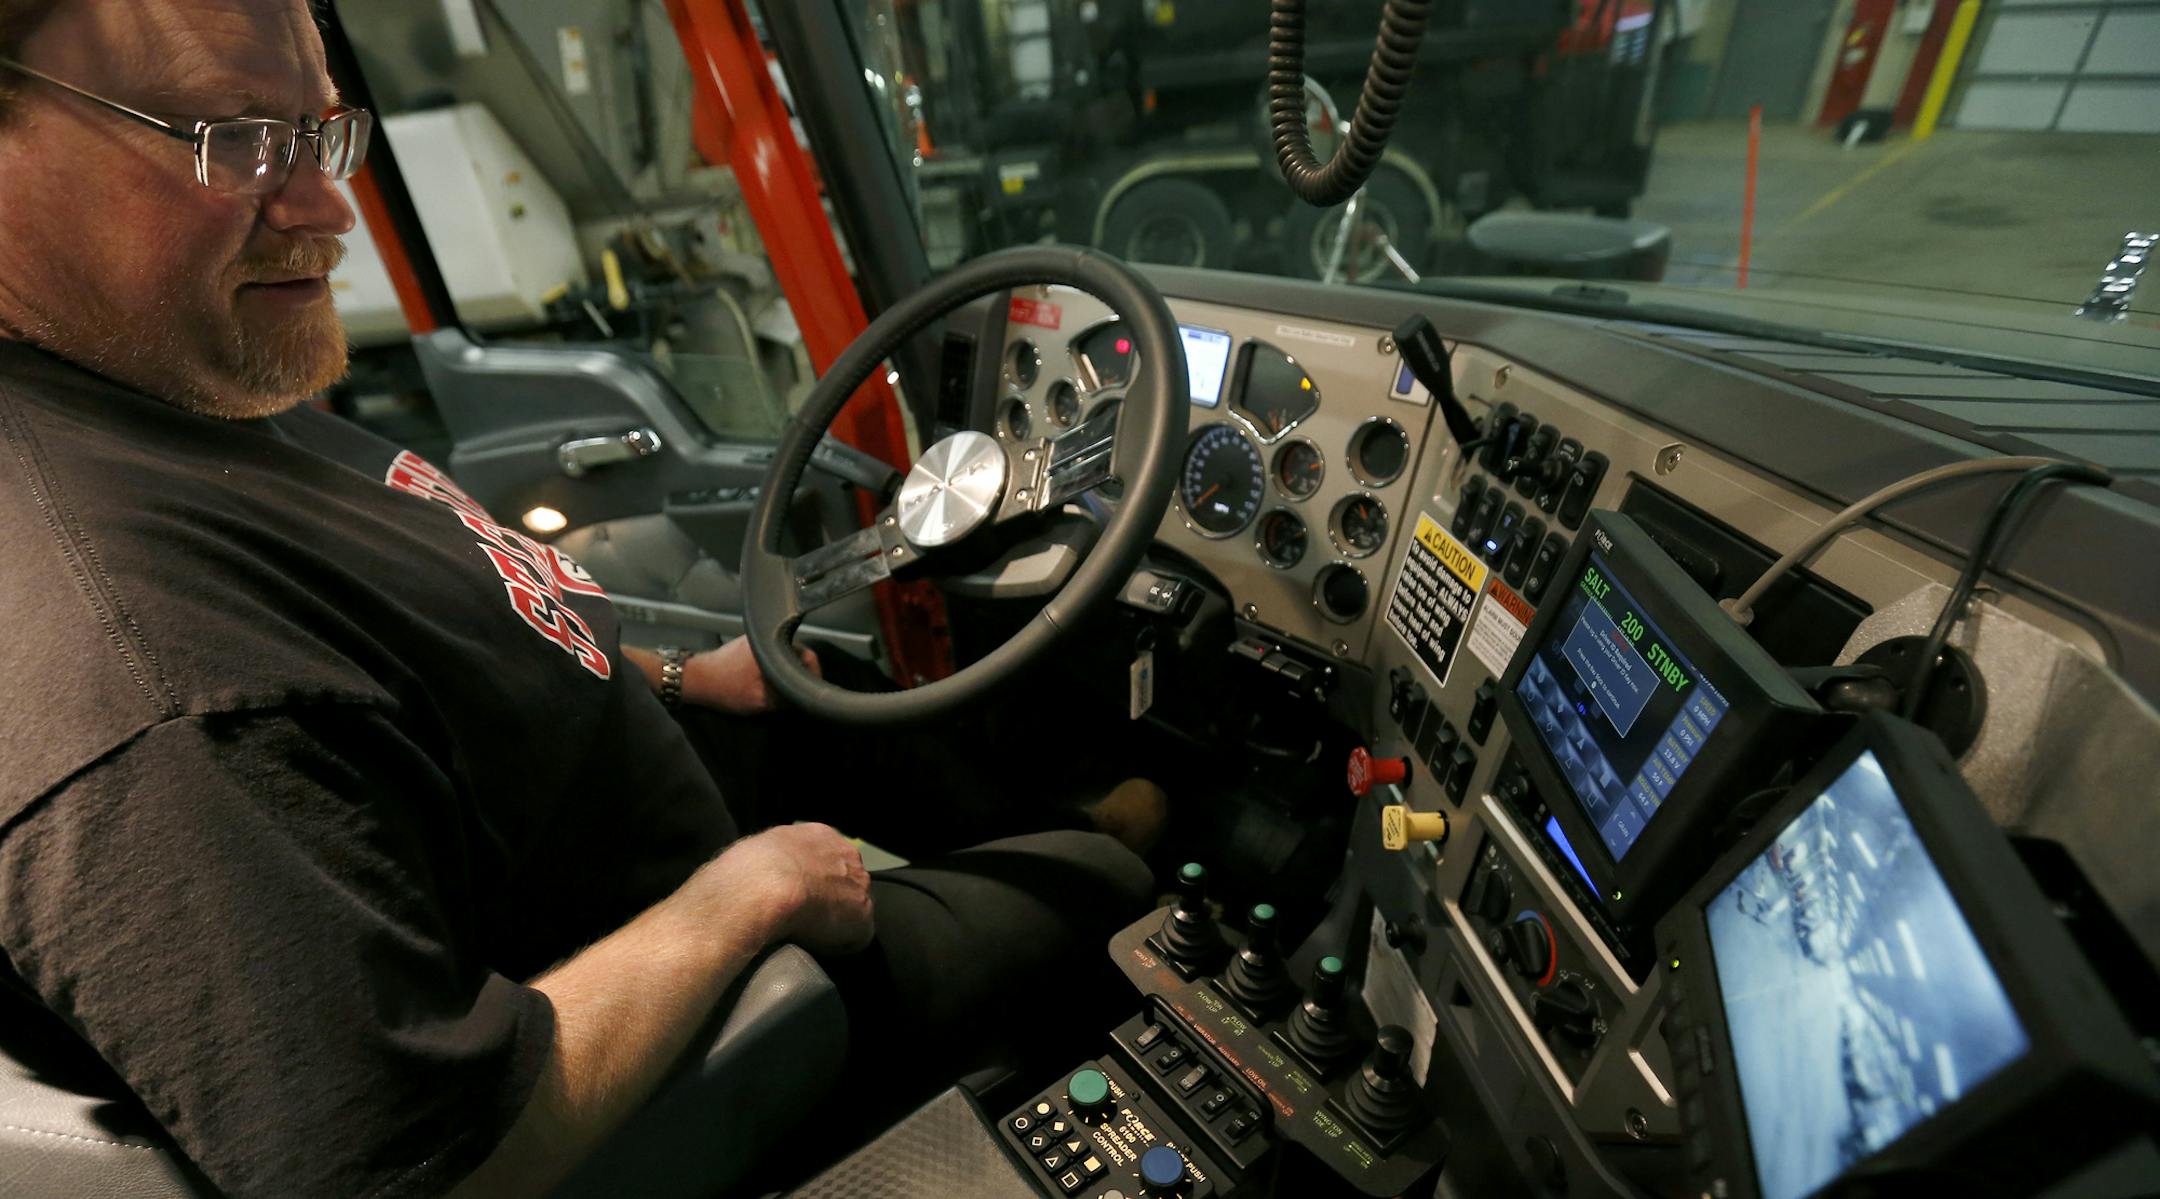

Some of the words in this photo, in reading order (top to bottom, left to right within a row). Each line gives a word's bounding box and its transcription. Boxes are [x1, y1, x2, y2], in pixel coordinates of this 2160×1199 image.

[1410, 538, 1421, 556] To
[1418, 546, 1438, 572] avoid
[1434, 563, 1464, 599] damage
[1461, 588, 1472, 604] to
[1430, 530, 1476, 581] CAUTION
[1415, 582, 1428, 602] toe
[1425, 593, 1436, 610] of
[1432, 600, 1452, 629] wing
[1437, 584, 1469, 624] ALWAYS
[1495, 584, 1535, 626] WARNIN
[1420, 625, 1430, 643] of
[1426, 634, 1446, 664] wing
[1429, 616, 1444, 638] and
[1584, 566, 1610, 601] SALT
[1620, 610, 1644, 642] 200
[1646, 642, 1689, 694] STNBY
[1613, 647, 1632, 672] Required
[1108, 1080, 1125, 1098] PUSH
[1100, 1122, 1137, 1162] SPREADER
[1119, 1125, 1136, 1143] 6100
[1121, 1108, 1155, 1142] FORCE
[1092, 1131, 1125, 1167] CONTROL
[1185, 1163, 1206, 1183] PUSH
